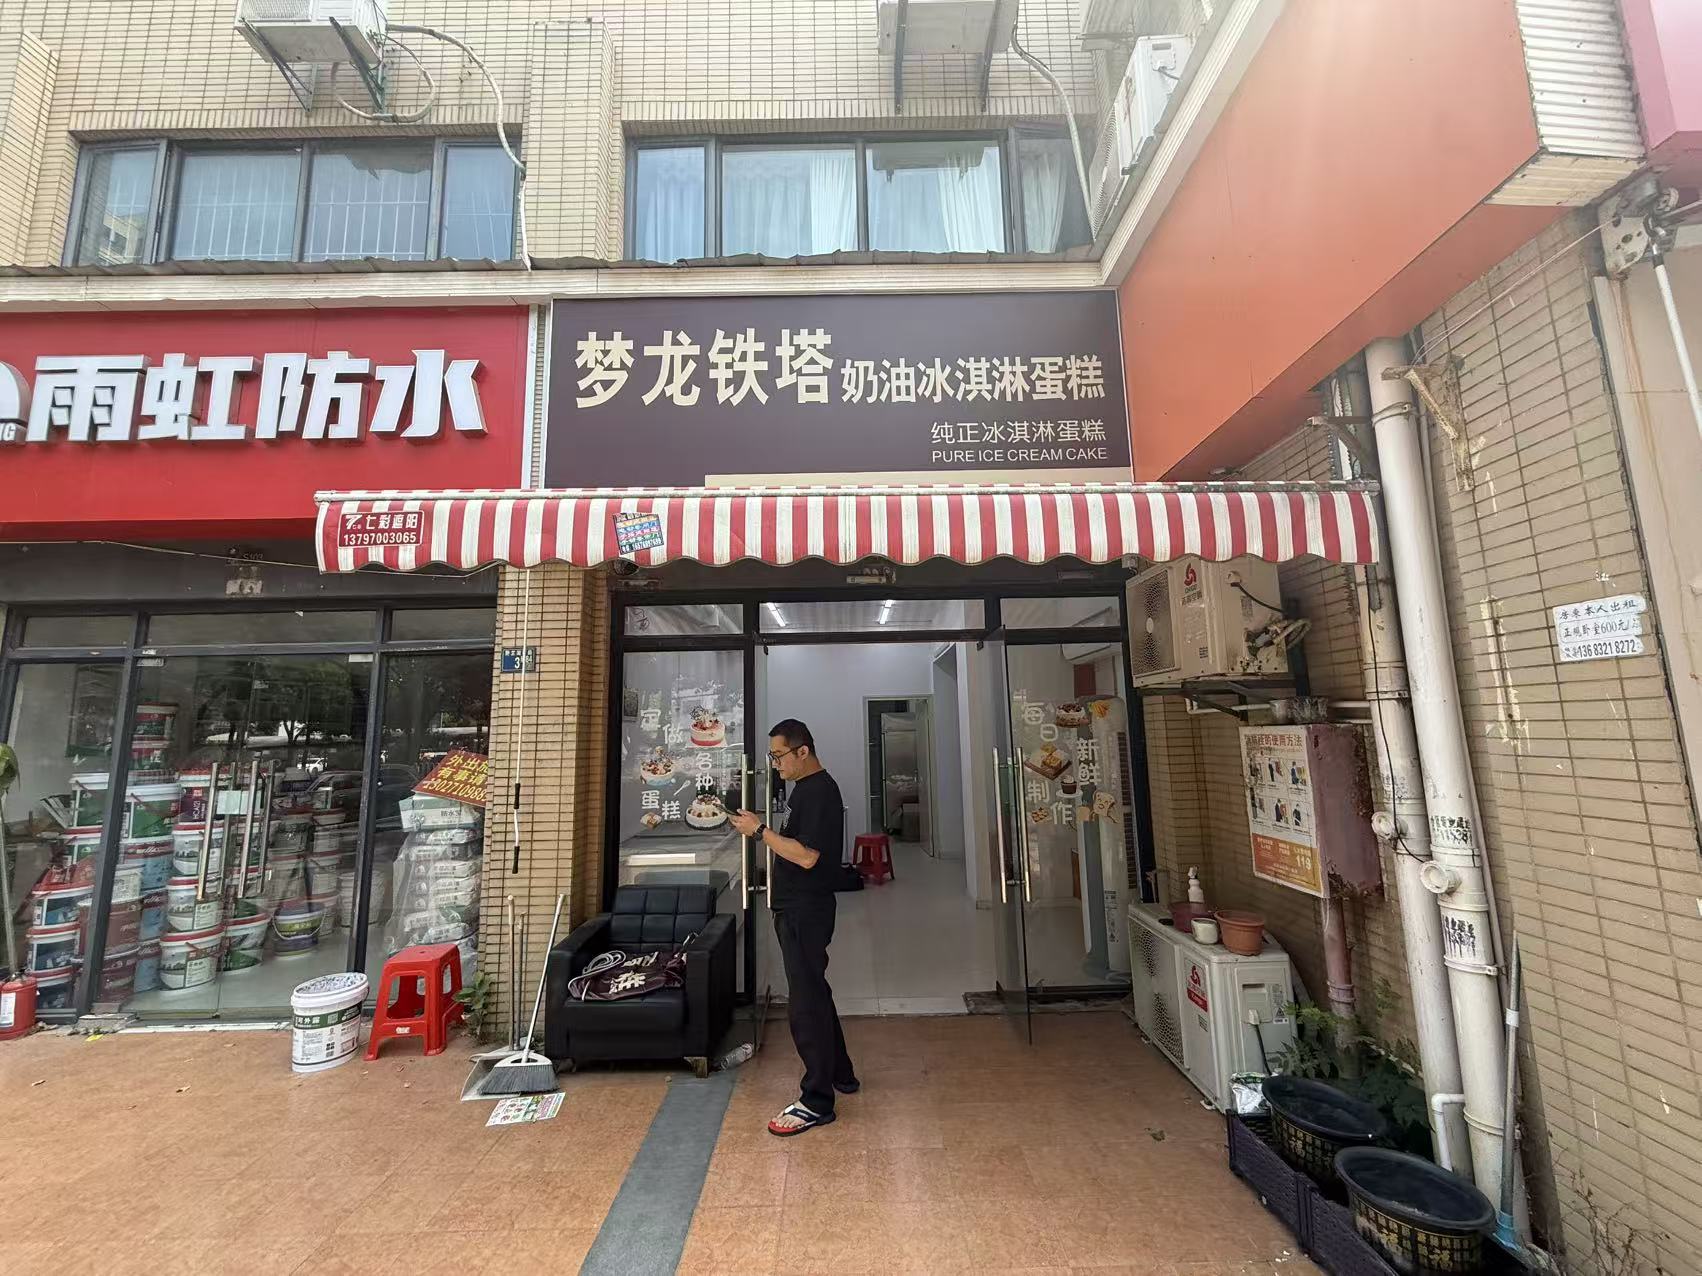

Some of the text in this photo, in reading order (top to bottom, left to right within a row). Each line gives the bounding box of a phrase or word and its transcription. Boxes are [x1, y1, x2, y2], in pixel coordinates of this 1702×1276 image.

[575, 328, 1106, 409] 梦龙铁塔 奶油冰淇淋蛋糕
[26, 350, 481, 442] 雨虹防水
[930, 419, 1107, 444] 纯正冰淇淋蛋糕
[932, 447, 1108, 464] PURE ICE CREAM CAKE
[366, 513, 419, 531] 七彩遮阳
[344, 532, 417, 545] 13797003065
[1578, 645, 1593, 658] 136
[1594, 642, 1613, 657] 8321
[1615, 639, 1637, 654] 8272
[641, 789, 681, 821] 蛋糕
